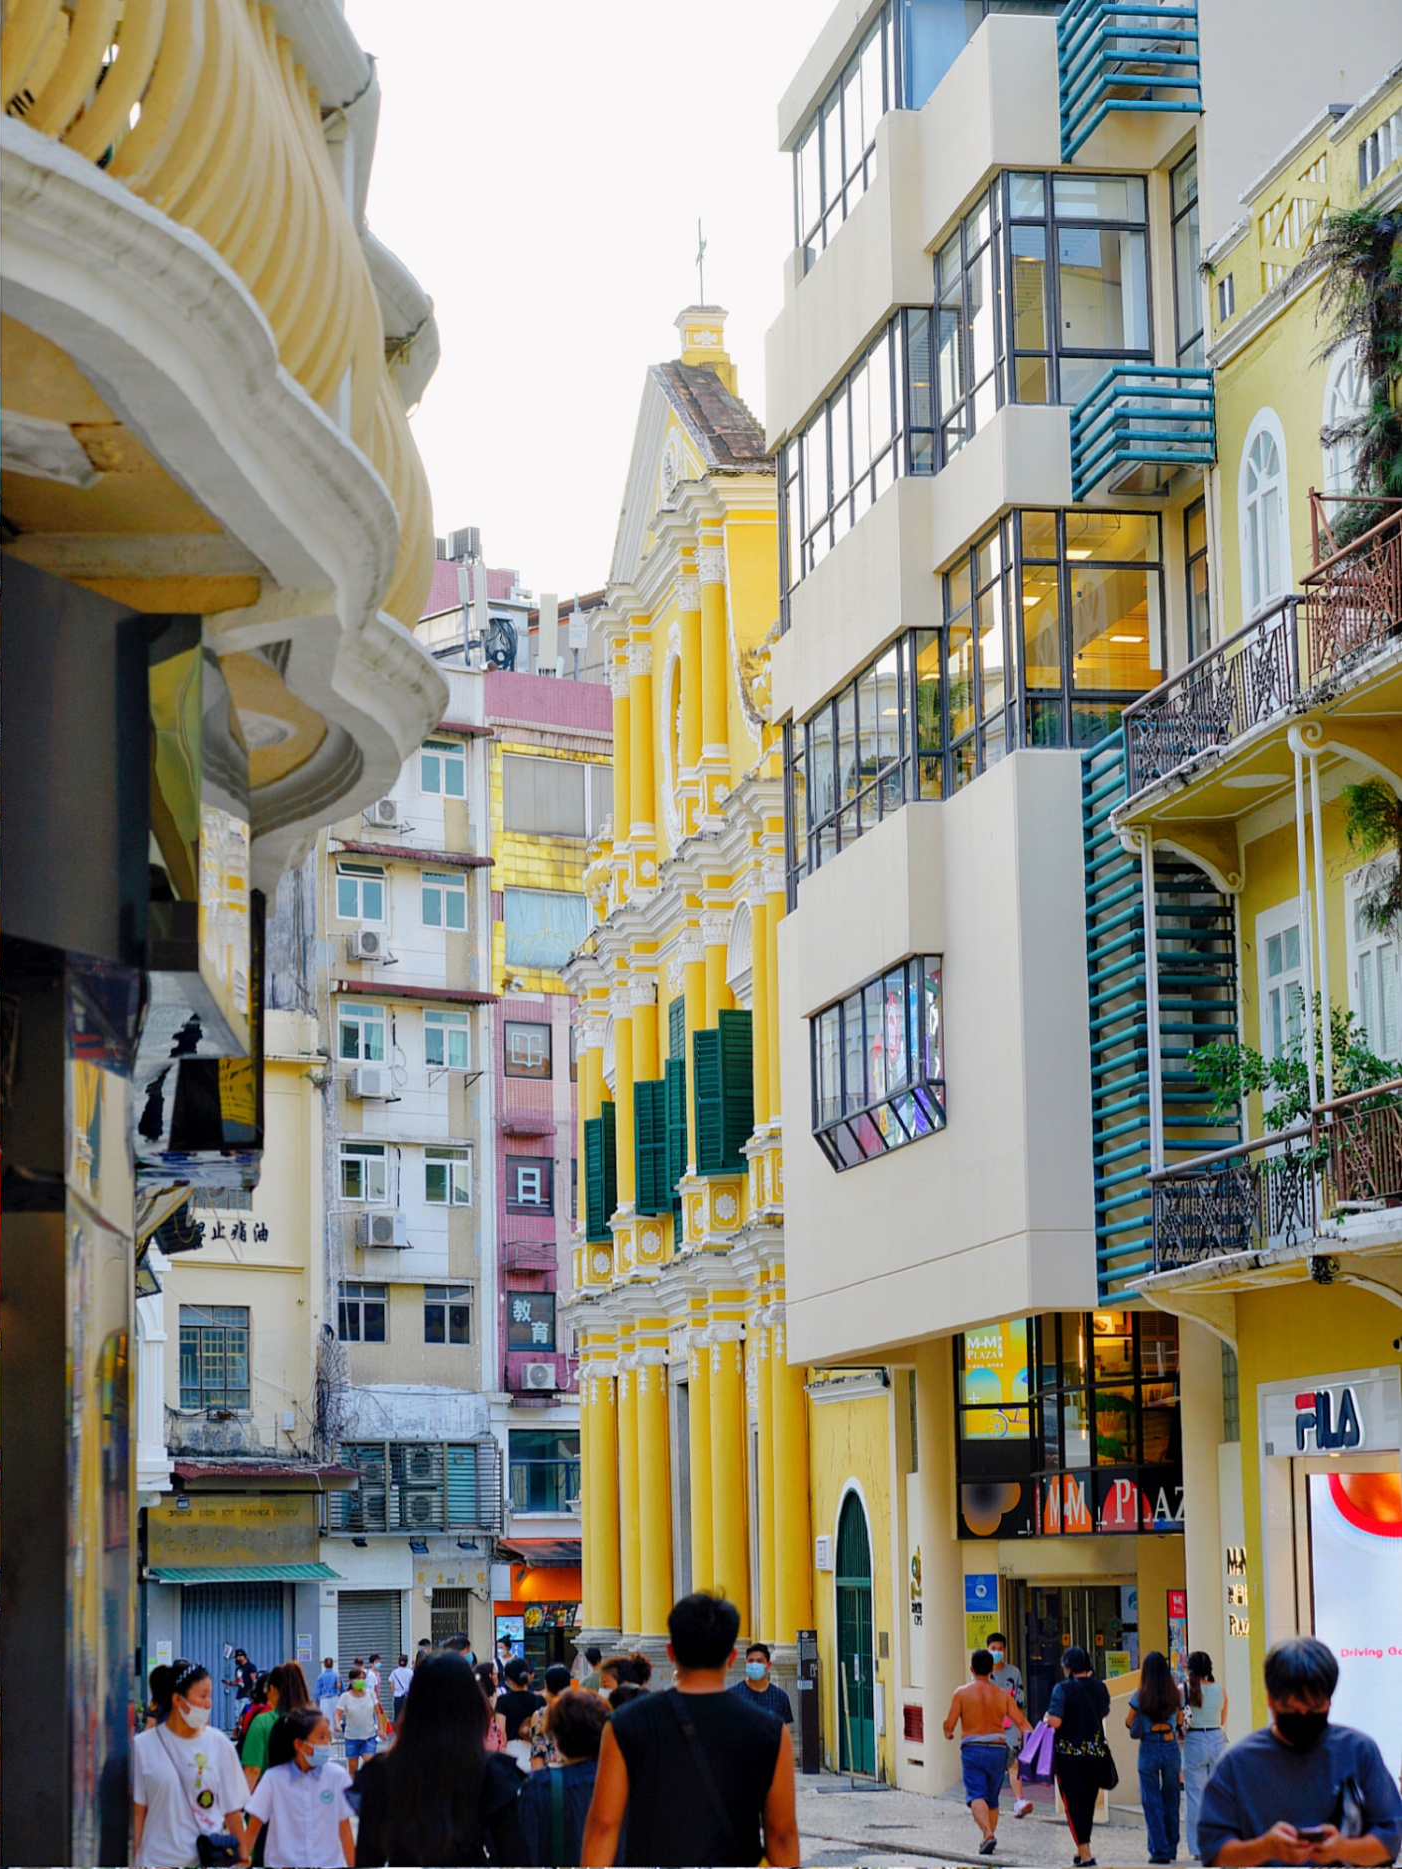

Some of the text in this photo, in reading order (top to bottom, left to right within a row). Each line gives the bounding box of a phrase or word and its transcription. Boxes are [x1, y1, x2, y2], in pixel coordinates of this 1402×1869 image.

[512, 1299, 550, 1345] 教育
[1295, 1387, 1361, 1450] FILA
[1113, 1478, 1186, 1524] PLAZ
[1340, 1648, 1383, 1659] Driving
